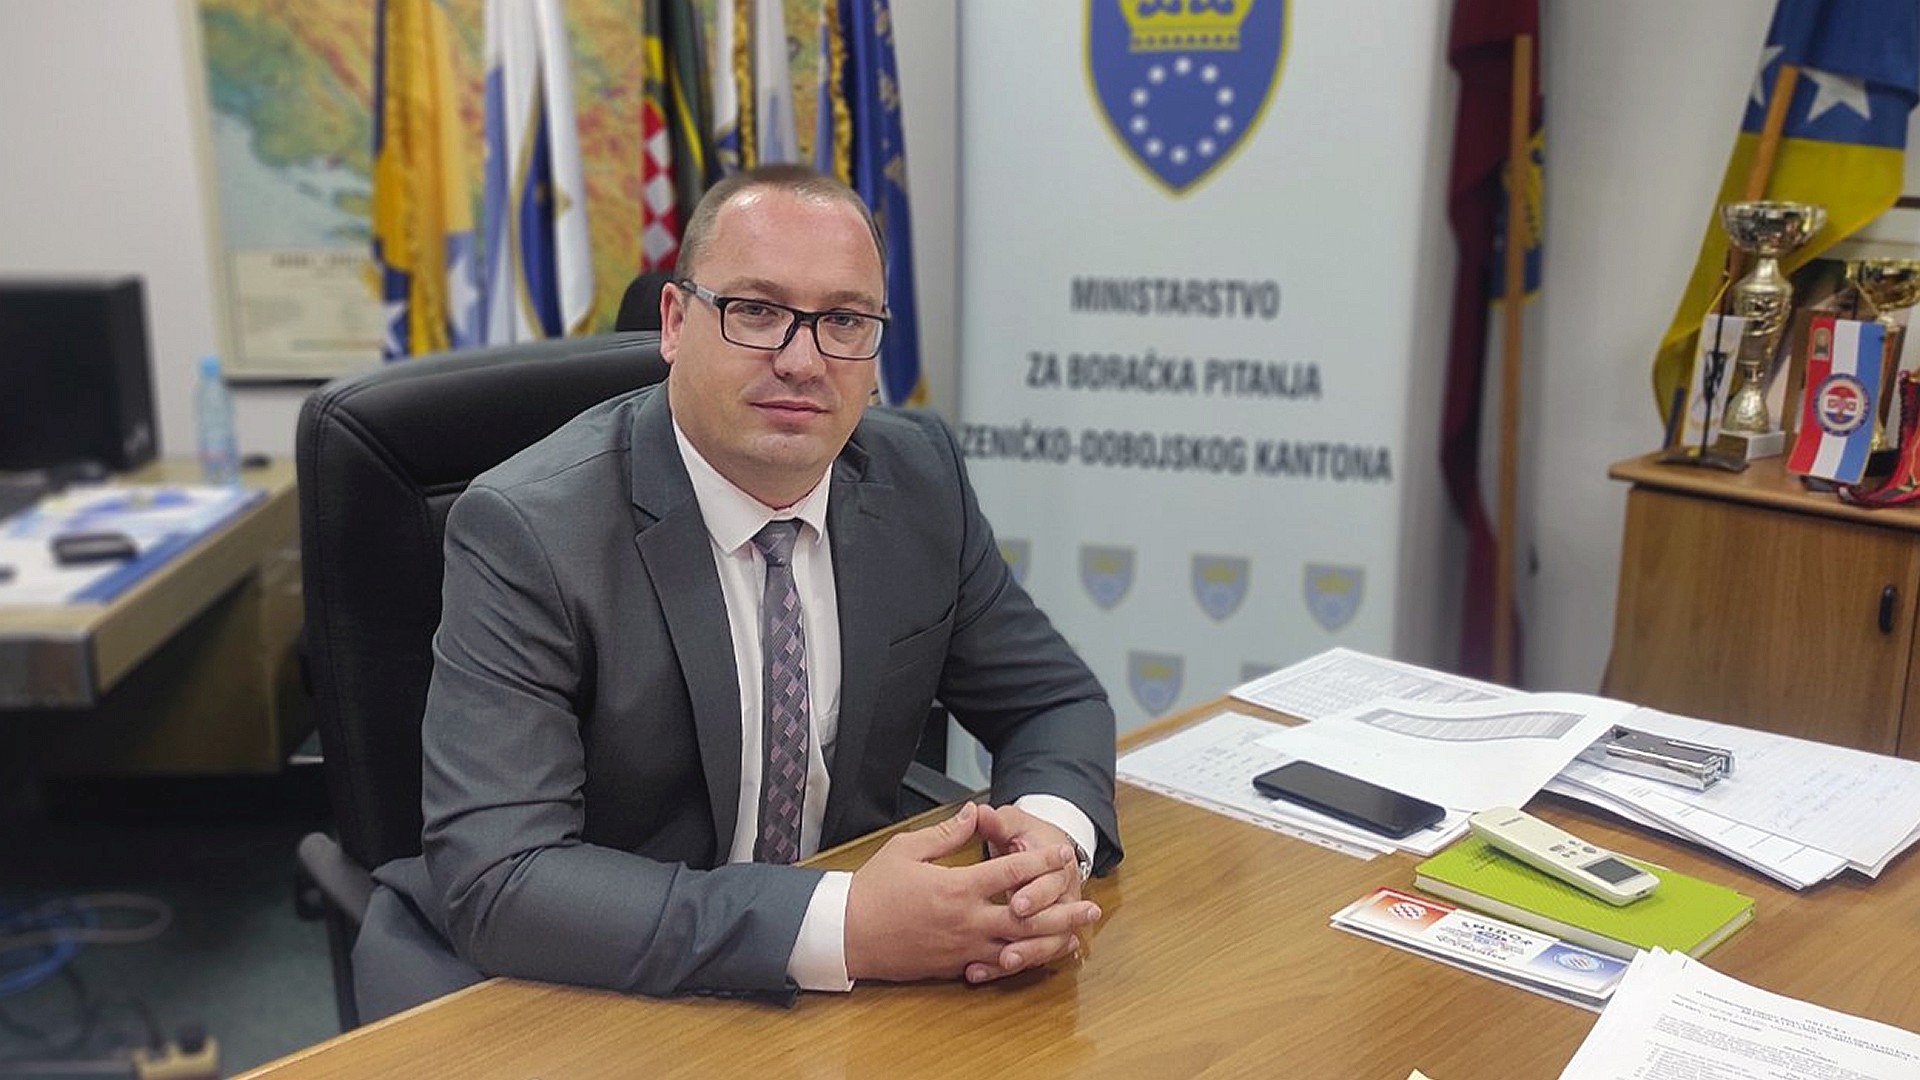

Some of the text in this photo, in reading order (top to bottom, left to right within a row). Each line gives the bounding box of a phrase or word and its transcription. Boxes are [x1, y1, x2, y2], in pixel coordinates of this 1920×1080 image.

[1071, 277, 1280, 319] MINISTARSTVO
[1026, 349, 1322, 399] ZA BORAČKA PITANJA
[963, 418, 1392, 481] ZENIČKO-DOBOJSKOG KANTONA
